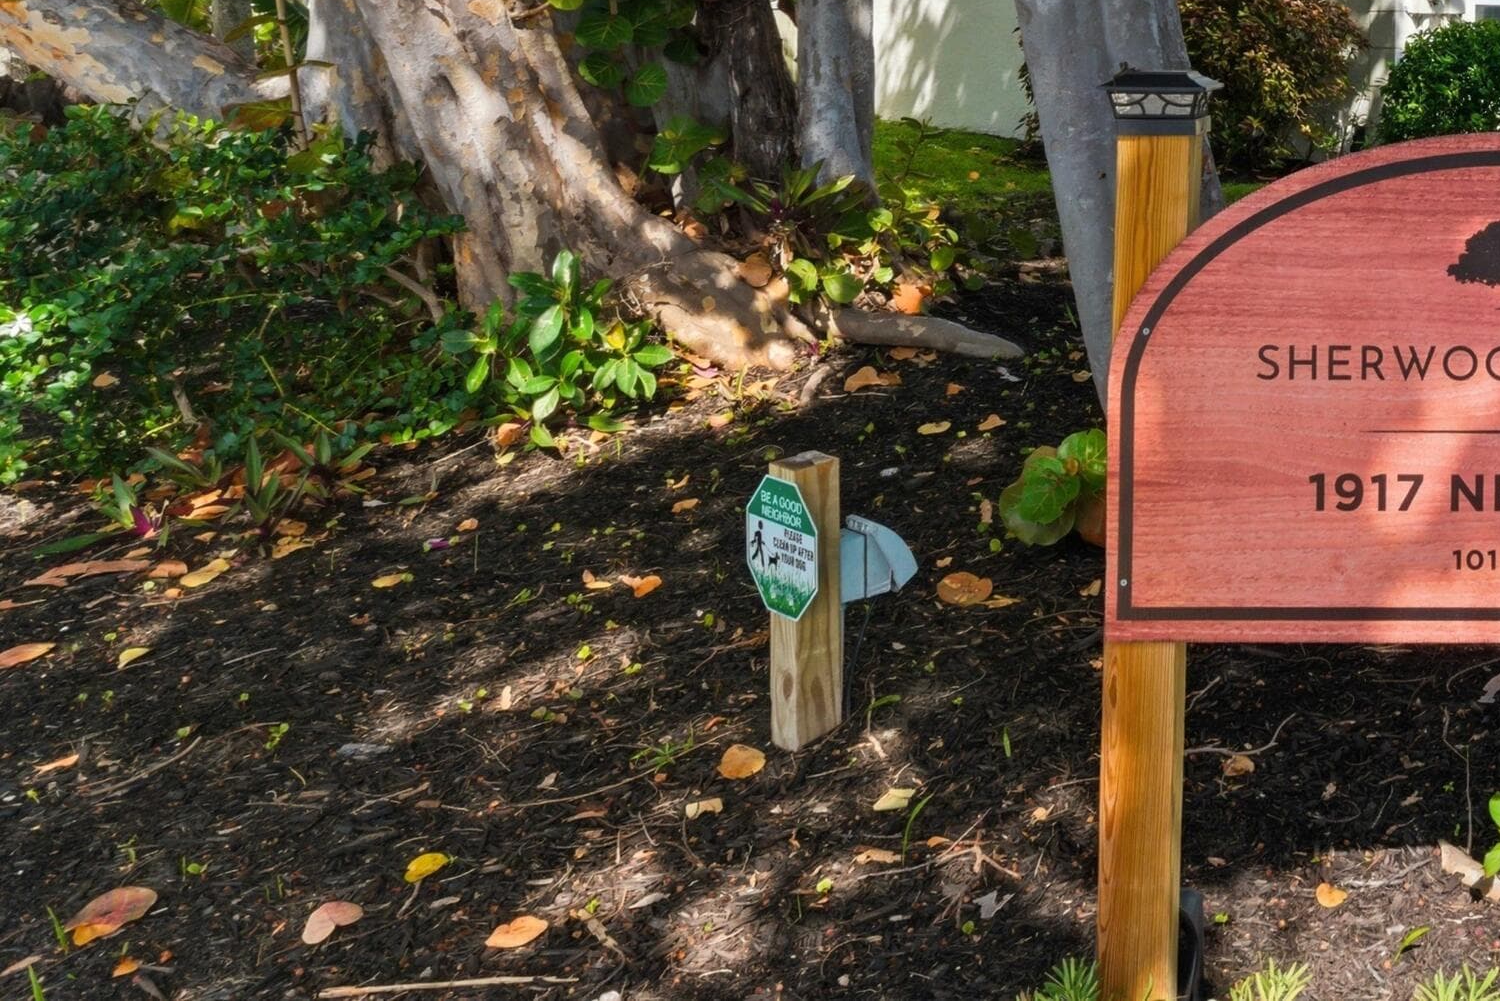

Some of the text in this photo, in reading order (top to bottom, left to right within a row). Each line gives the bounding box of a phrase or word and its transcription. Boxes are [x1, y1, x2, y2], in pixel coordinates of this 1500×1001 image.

[760, 490, 802, 515] BE A GOOD
[1309, 474, 1423, 512] 1917
[761, 504, 802, 528] NEIGHBOR
[784, 528, 803, 544] PLEASE
[773, 537, 814, 562] CLEAN UP AFTER
[781, 553, 795, 566] YOUR
[1453, 550, 1496, 570] 101
